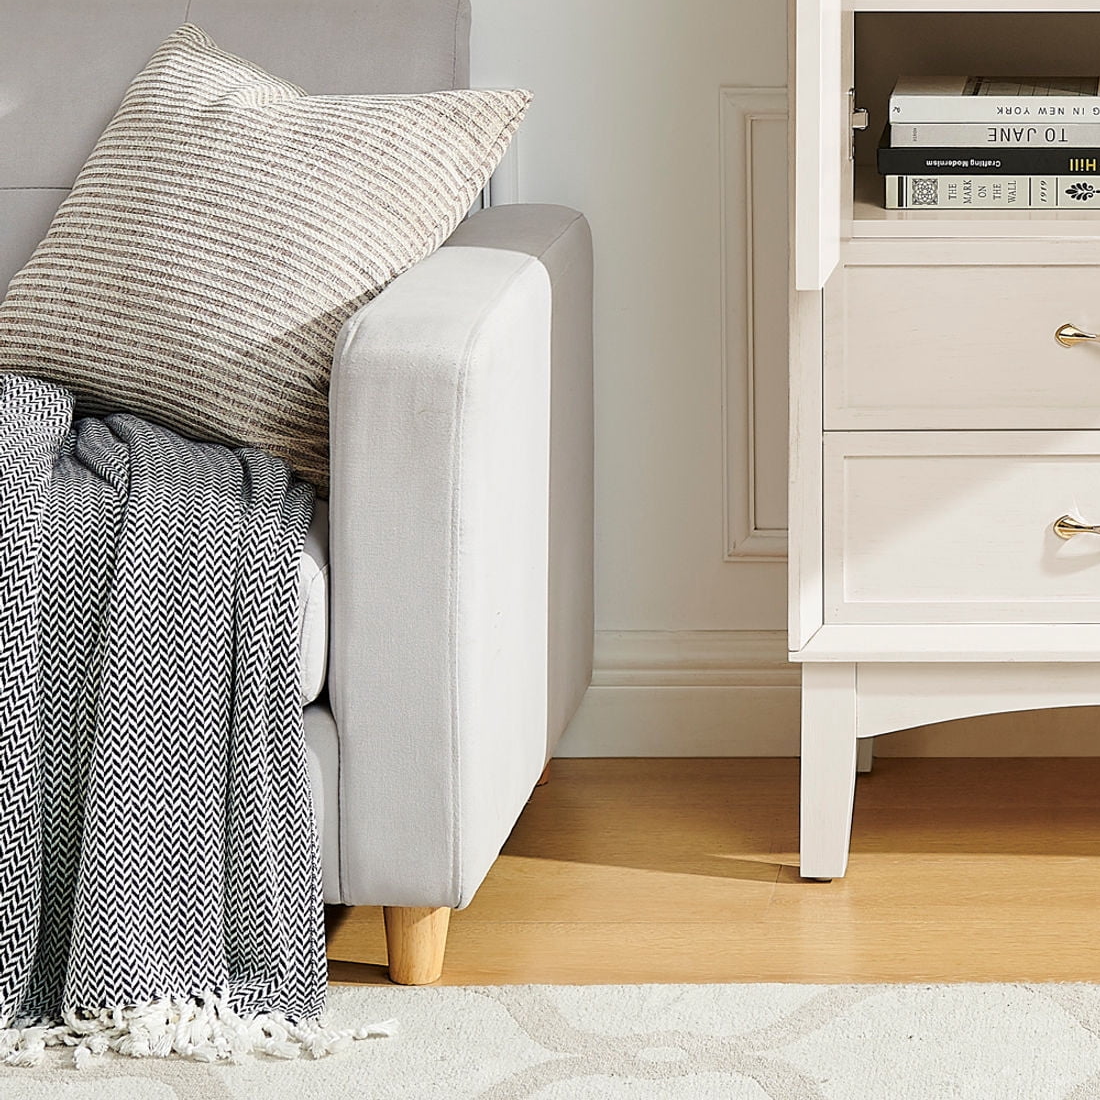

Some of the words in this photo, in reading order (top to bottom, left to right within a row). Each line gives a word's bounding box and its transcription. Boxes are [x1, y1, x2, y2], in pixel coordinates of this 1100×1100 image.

[996, 106, 1031, 115] YORK
[1037, 106, 1065, 116] NEW
[1072, 107, 1086, 116] IN
[987, 127, 1037, 143] JANE
[1044, 127, 1069, 143] TO
[925, 159, 968, 168] Modernism
[969, 158, 1002, 168] Crafting
[1069, 158, 1097, 172] Hill
[947, 183, 957, 201] THE
[962, 179, 972, 204] MARK
[977, 185, 987, 199] ON
[992, 183, 1002, 201] THE
[1007, 180, 1017, 204] WALL
[1039, 180, 1048, 203] 1919
